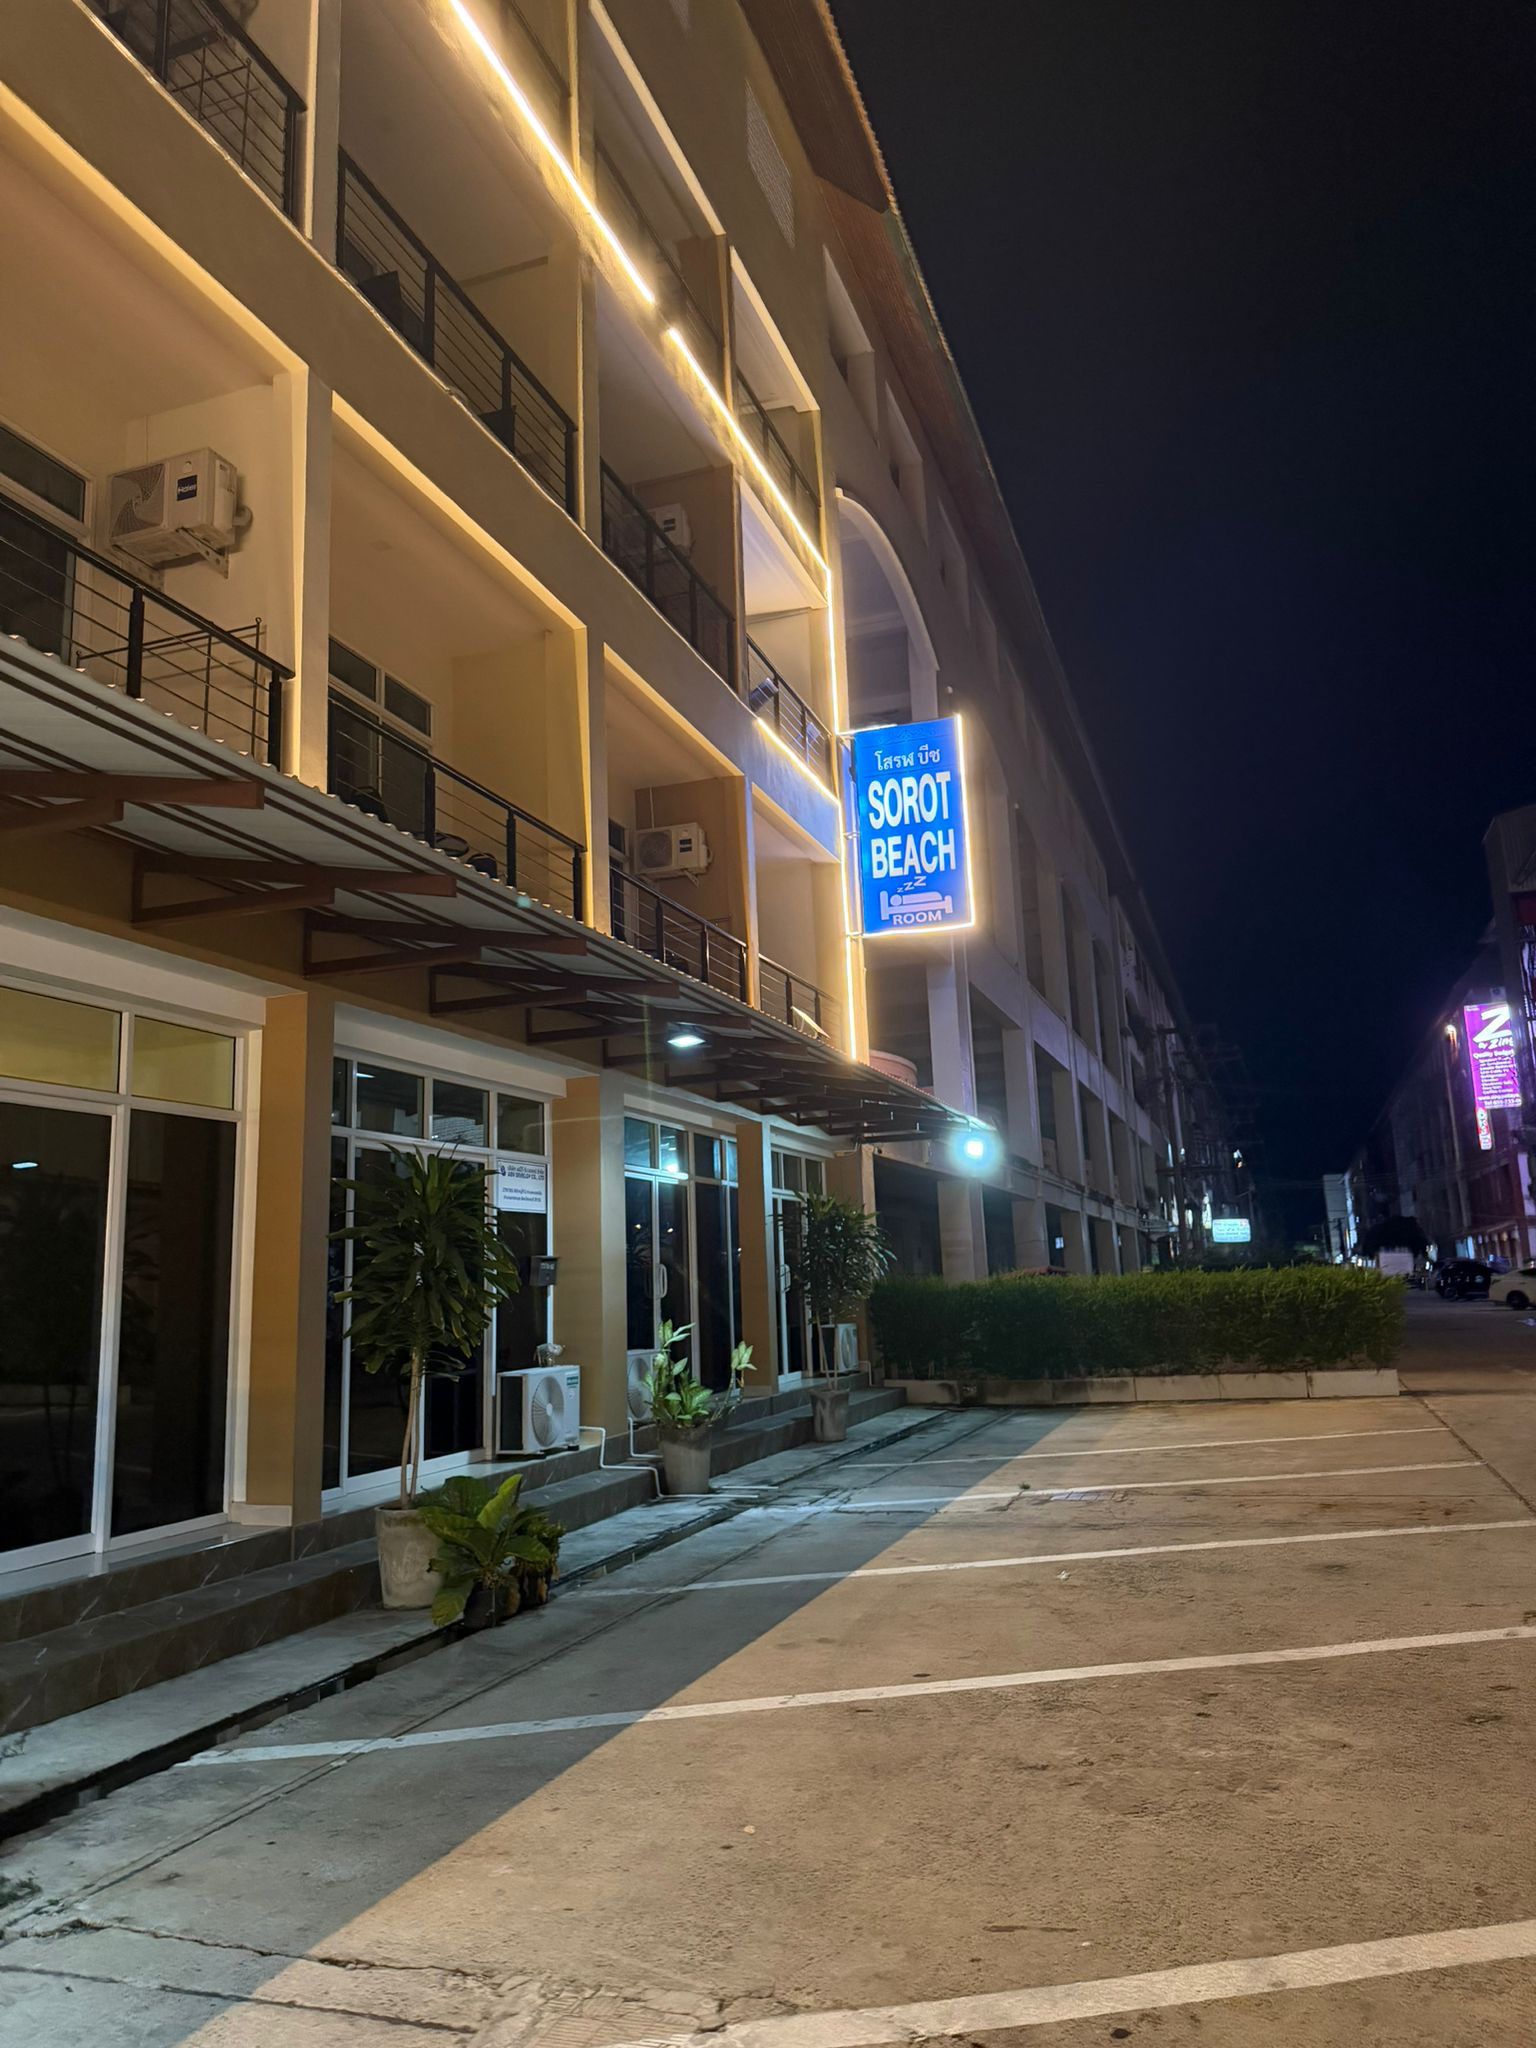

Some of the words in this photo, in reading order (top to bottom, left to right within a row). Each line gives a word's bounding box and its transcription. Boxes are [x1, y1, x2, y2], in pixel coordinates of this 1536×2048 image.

[868, 771, 951, 830] SOROT
[871, 829, 956, 879] BEACH
[893, 910, 942, 925] ROOM
